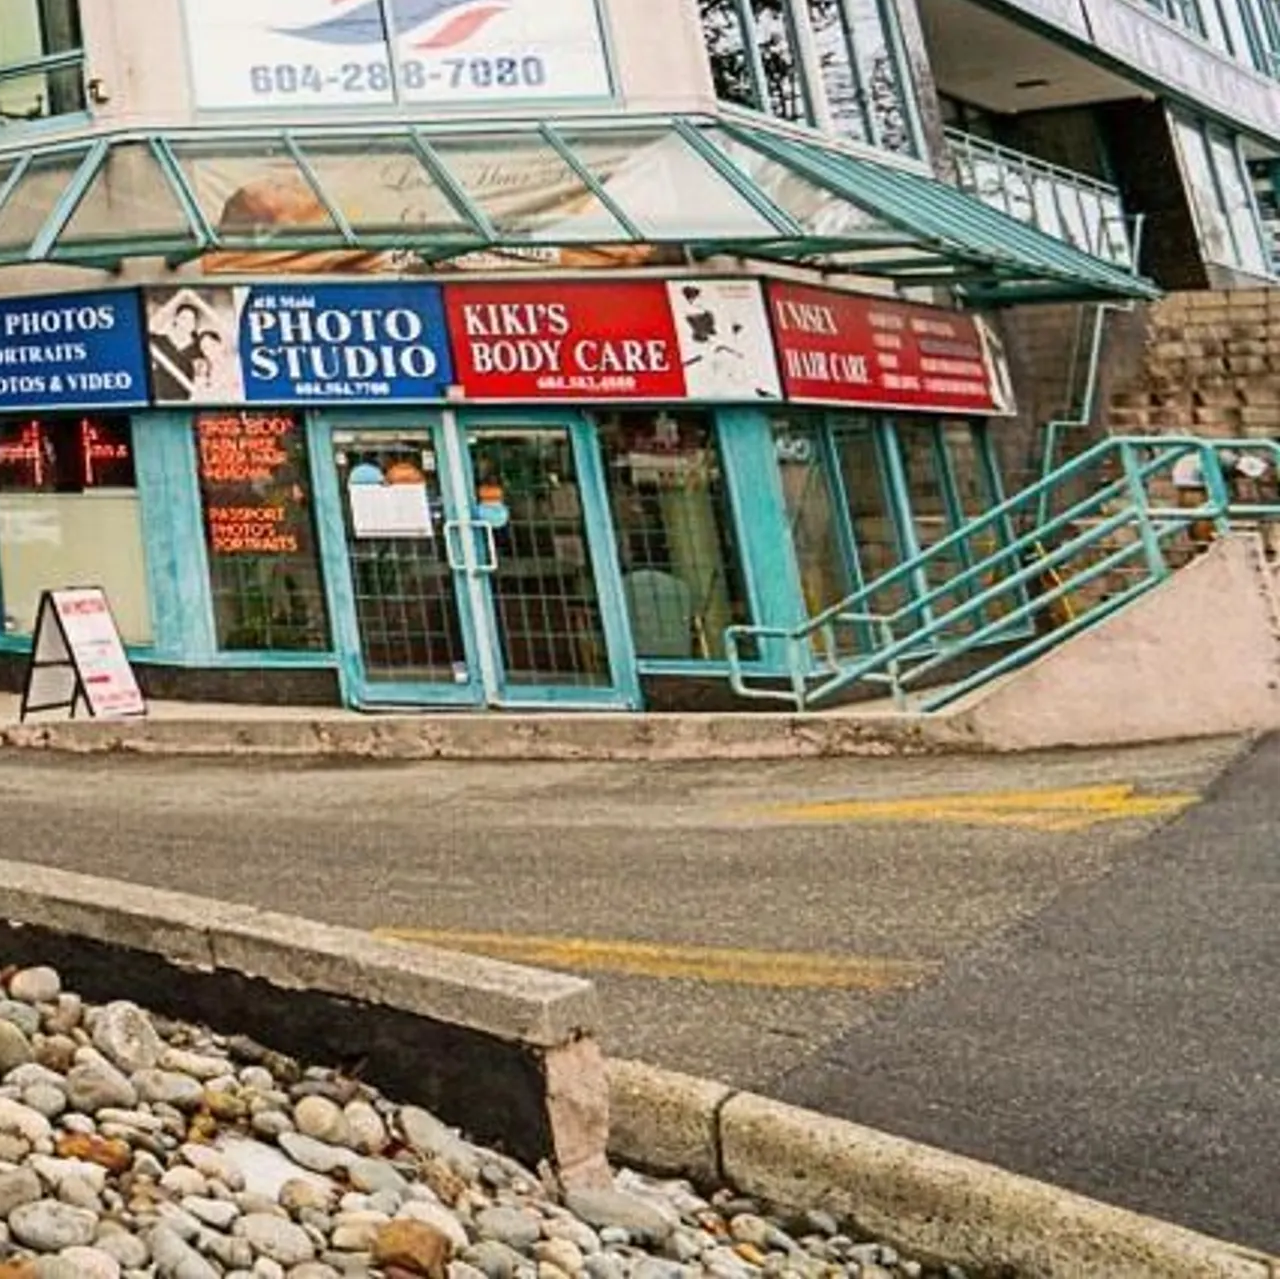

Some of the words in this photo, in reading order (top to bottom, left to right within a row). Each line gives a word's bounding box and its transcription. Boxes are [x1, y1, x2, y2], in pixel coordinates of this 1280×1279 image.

[249, 55, 547, 95] 604-288-7080
[6, 305, 115, 336] PHOTOS
[248, 308, 423, 343] PHOTO
[463, 303, 569, 336] KIKI'S
[250, 344, 437, 380] STUDIO
[472, 340, 562, 372] BODY
[574, 339, 670, 372] CARE
[830, 352, 869, 384] CARE
[49, 375, 63, 392] &
[66, 371, 132, 391] VIDEO
[209, 507, 285, 521] PASSPORT
[213, 536, 297, 552] PORTRAITS
